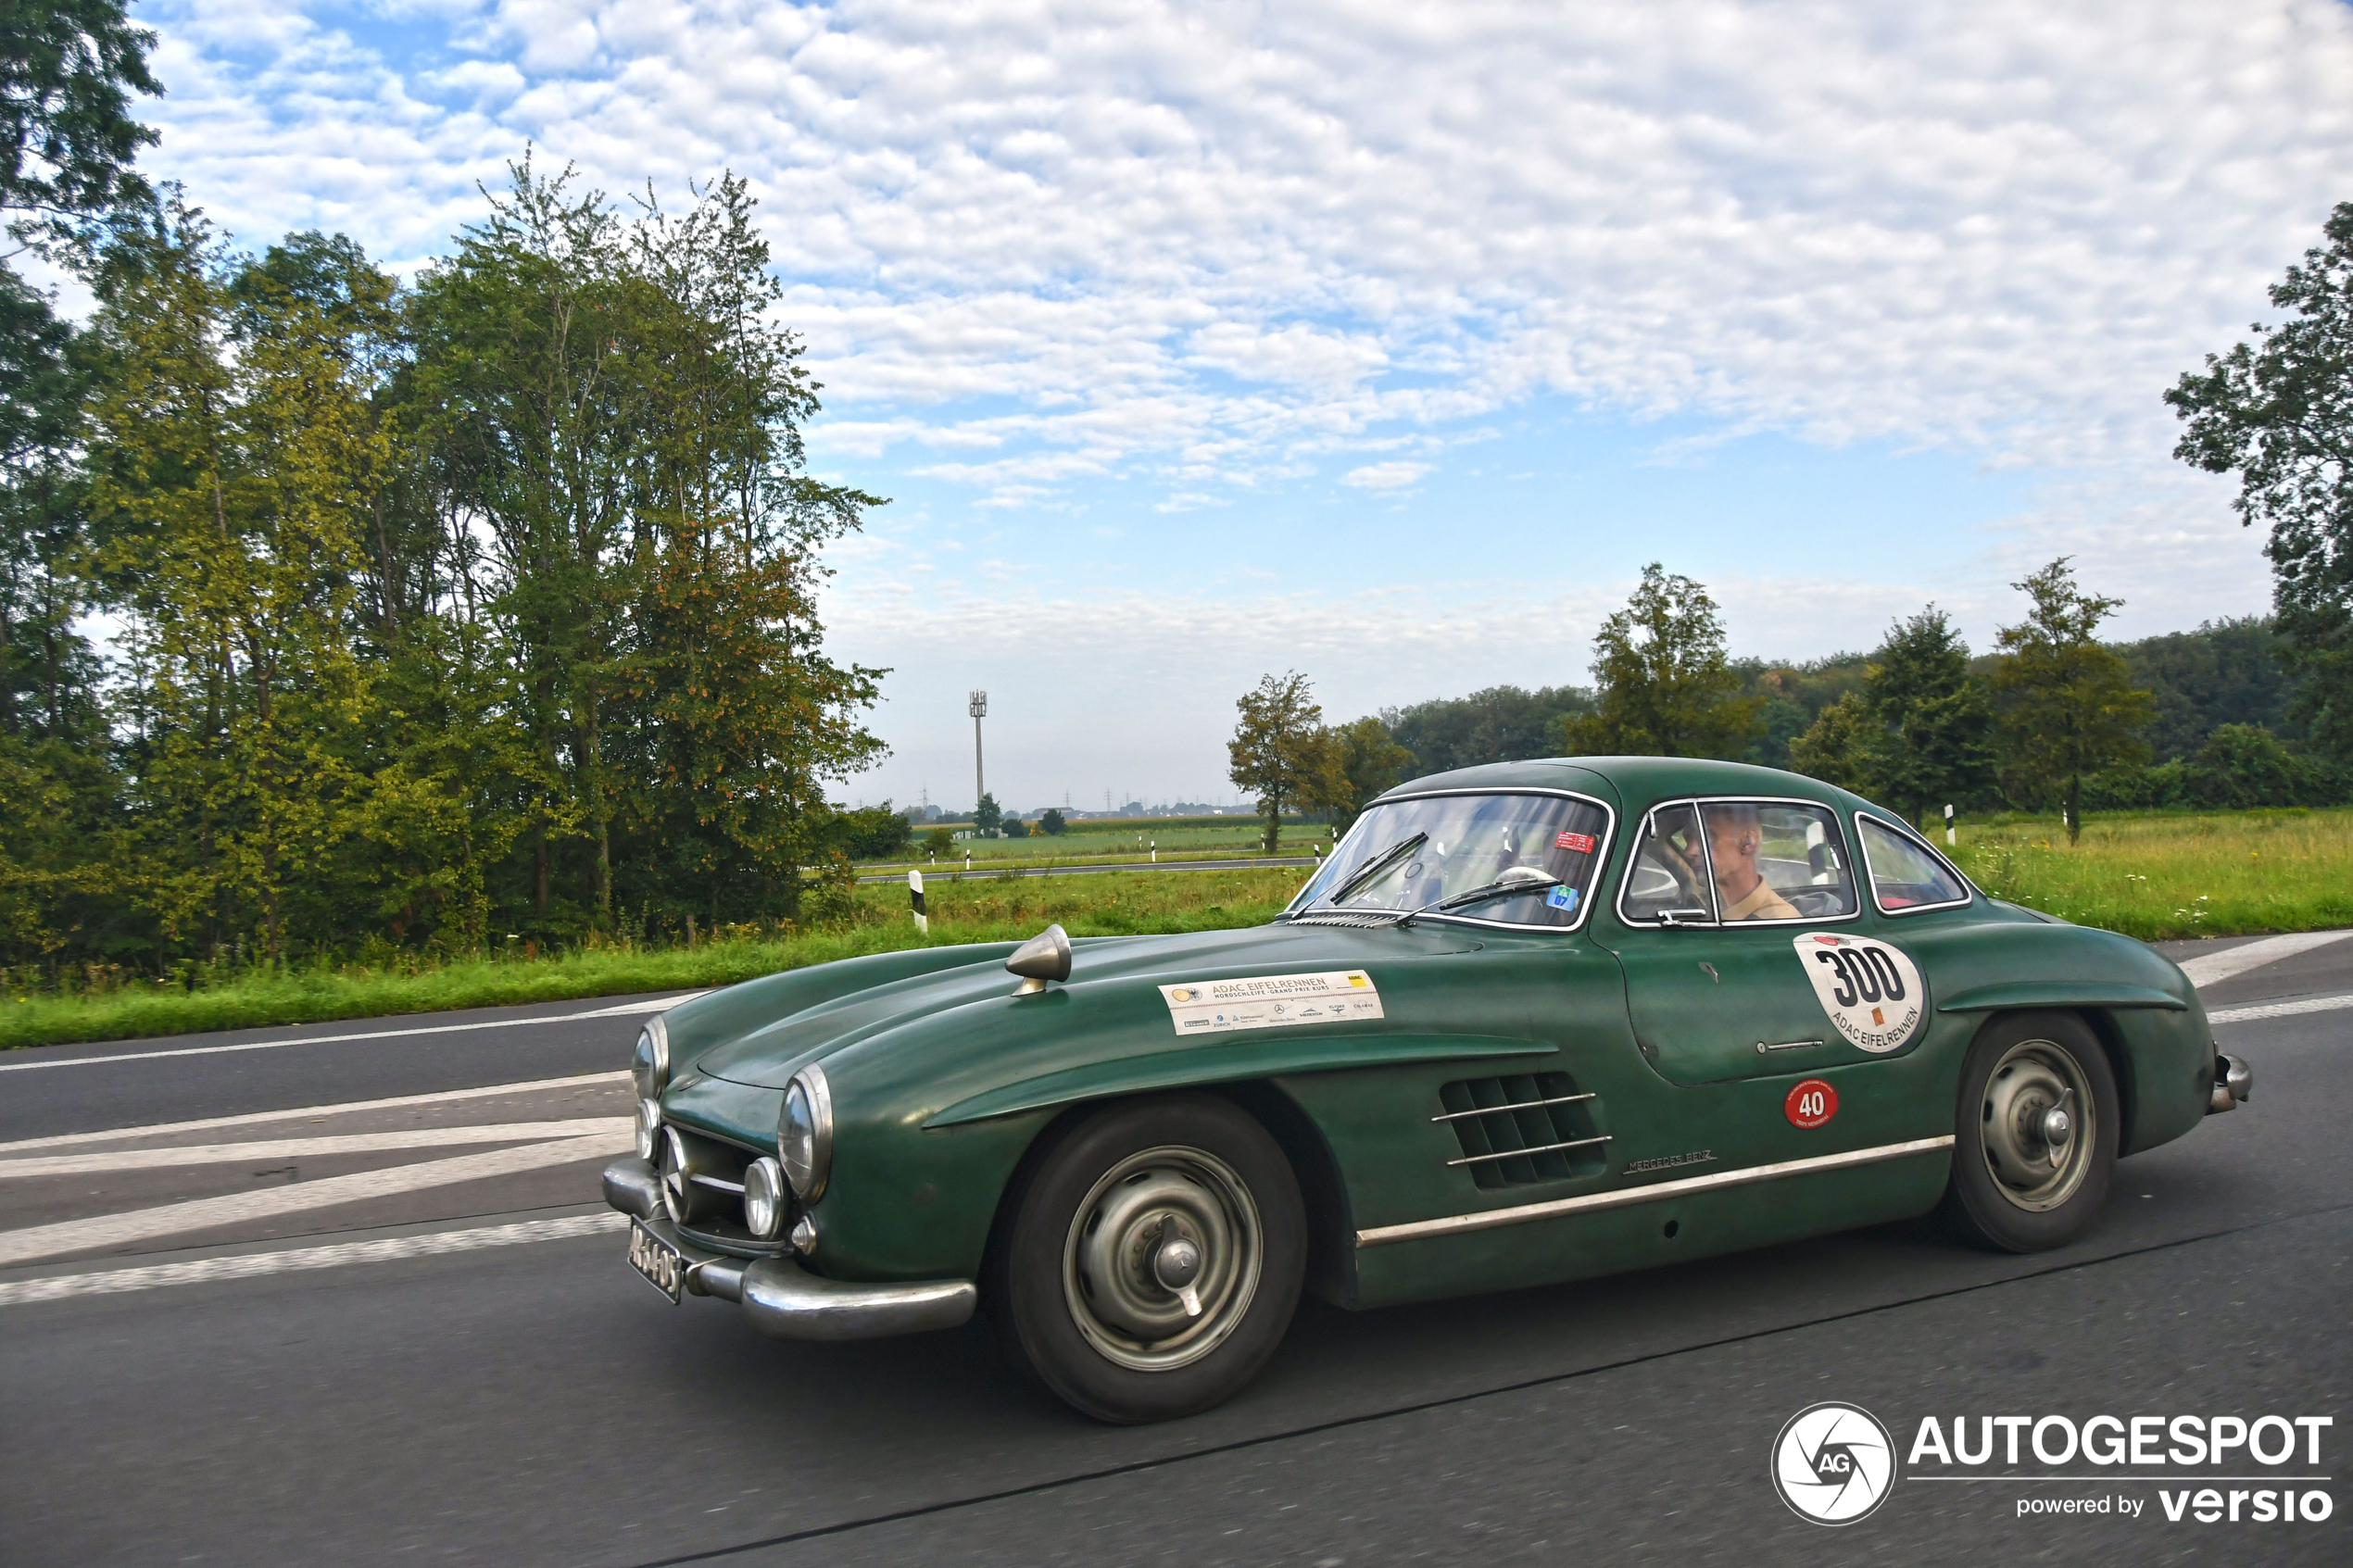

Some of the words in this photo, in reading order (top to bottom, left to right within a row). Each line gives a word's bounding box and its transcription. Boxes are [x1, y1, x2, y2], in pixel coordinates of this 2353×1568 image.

[1554, 896, 1567, 907] 07
[1213, 983, 1242, 994] ADAC
[1247, 977, 1327, 992] EIFELRENNEN
[1816, 947, 1906, 1008] 300
[1214, 990, 1266, 999] NORDSCHLEIFE
[1832, 1011, 1859, 1040] ADAC
[1861, 1006, 1919, 1047] EIFELRENNEN
[1799, 1091, 1825, 1117] 40
[1629, 1155, 1681, 1172] MERCEDES
[1686, 1149, 1711, 1162] BENZ
